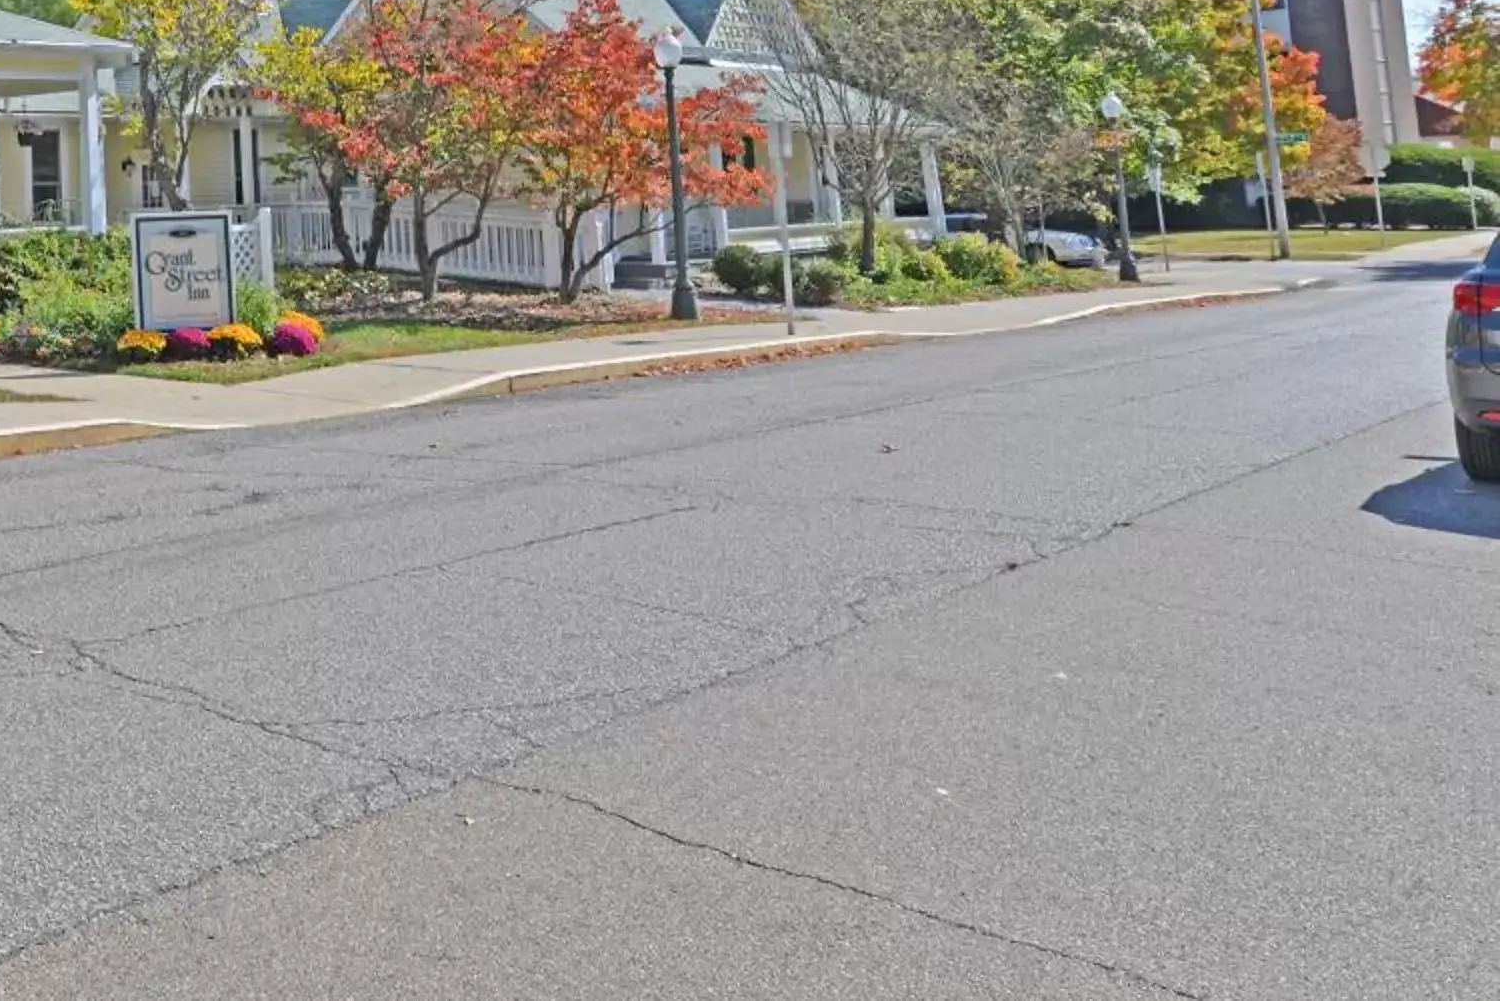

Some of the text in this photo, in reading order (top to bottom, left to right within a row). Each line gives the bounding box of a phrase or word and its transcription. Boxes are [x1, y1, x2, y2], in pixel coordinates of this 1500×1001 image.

[145, 248, 197, 275] Grant
[164, 265, 222, 292] Street
[188, 285, 211, 301] Inn
